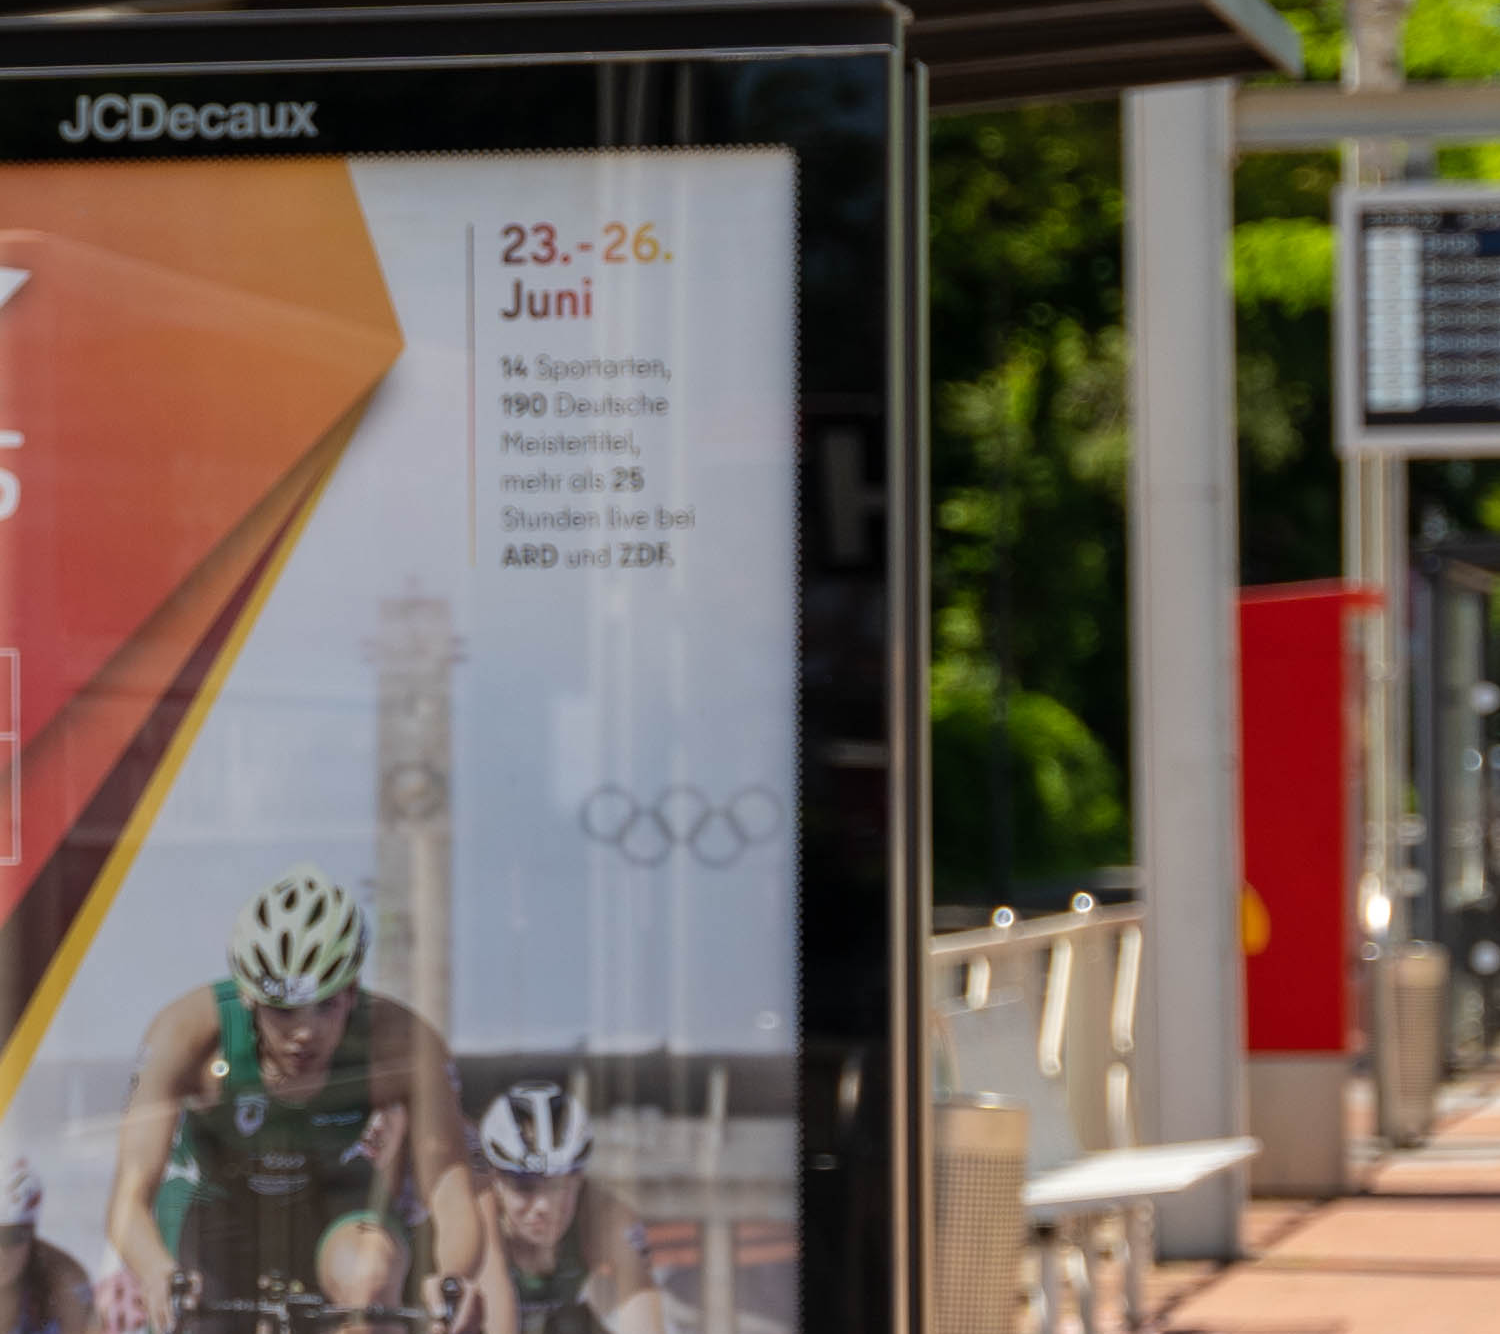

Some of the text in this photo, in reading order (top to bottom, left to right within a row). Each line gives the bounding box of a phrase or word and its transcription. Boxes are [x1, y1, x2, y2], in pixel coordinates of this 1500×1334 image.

[57, 93, 320, 142] JCDecaux
[500, 277, 594, 321] Juni
[499, 353, 673, 383] 14 Sportarten,
[500, 391, 670, 418] 190 Deutsche
[500, 430, 641, 458] Meistertitel,
[501, 466, 646, 494] mehr als 25
[501, 505, 696, 533] Stunden live bei
[500, 543, 559, 569] ARD
[567, 547, 611, 569] und
